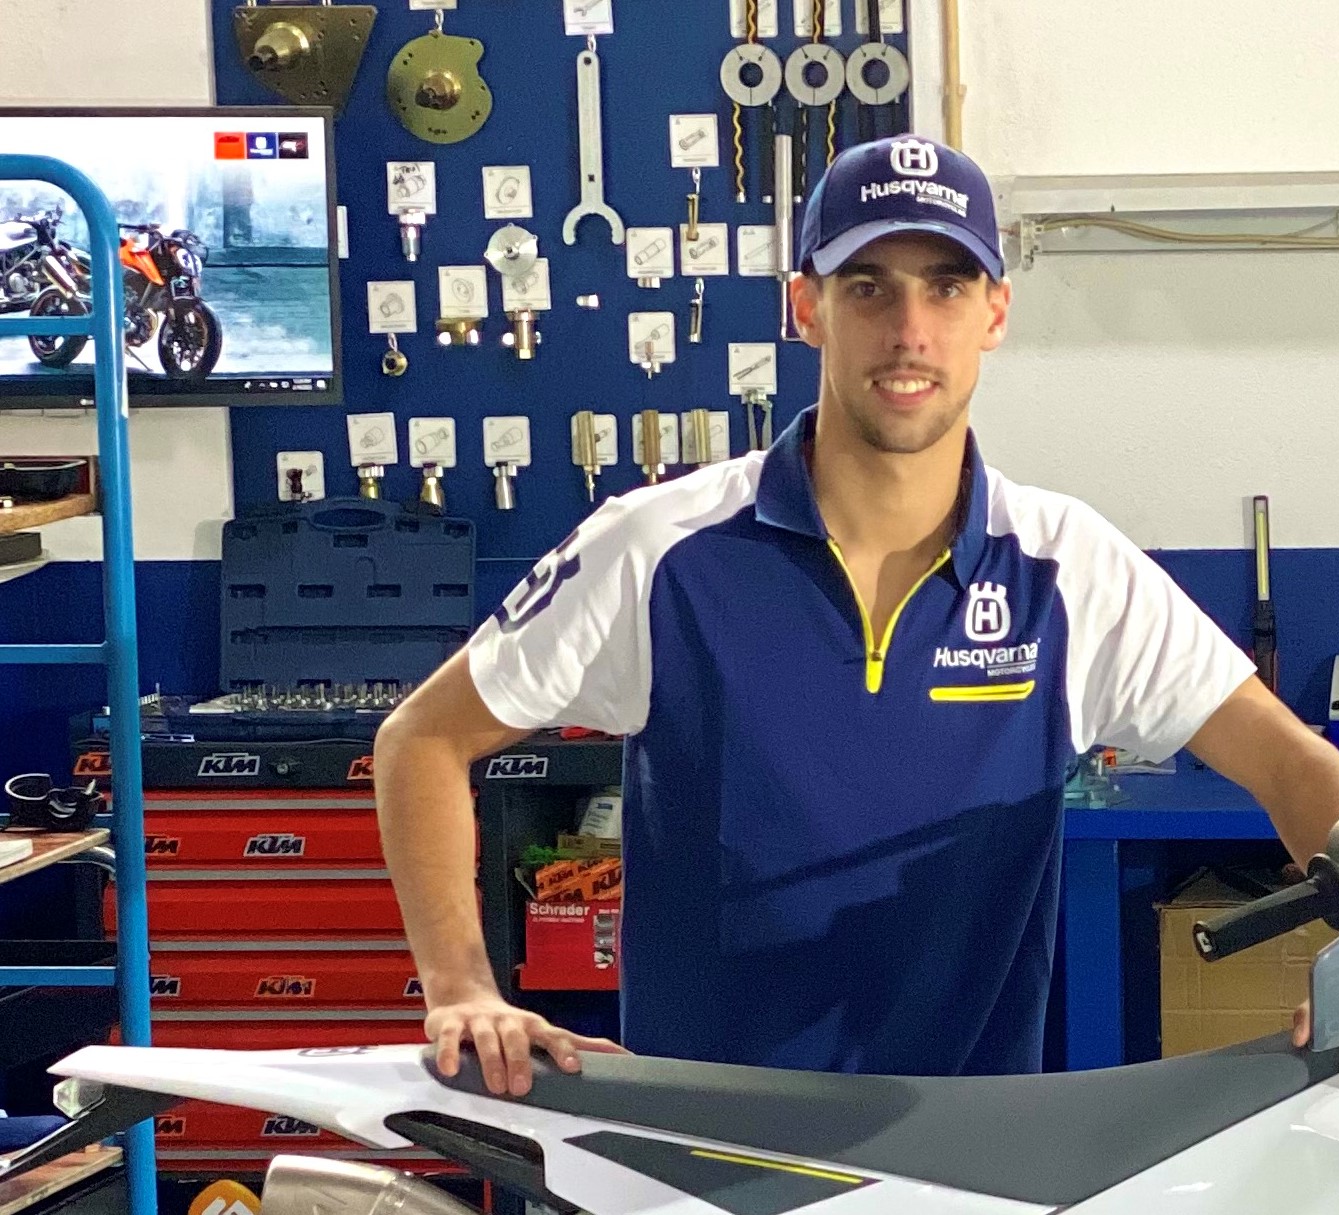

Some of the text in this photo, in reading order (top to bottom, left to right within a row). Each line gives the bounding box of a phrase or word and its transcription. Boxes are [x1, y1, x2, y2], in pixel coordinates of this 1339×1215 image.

[860, 180, 968, 208] Husqvarna
[933, 642, 1038, 669] Husqvarna
[201, 755, 257, 774] KTM
[489, 757, 546, 776] KTM
[248, 835, 303, 856] KTM
[529, 901, 591, 917] Schrader
